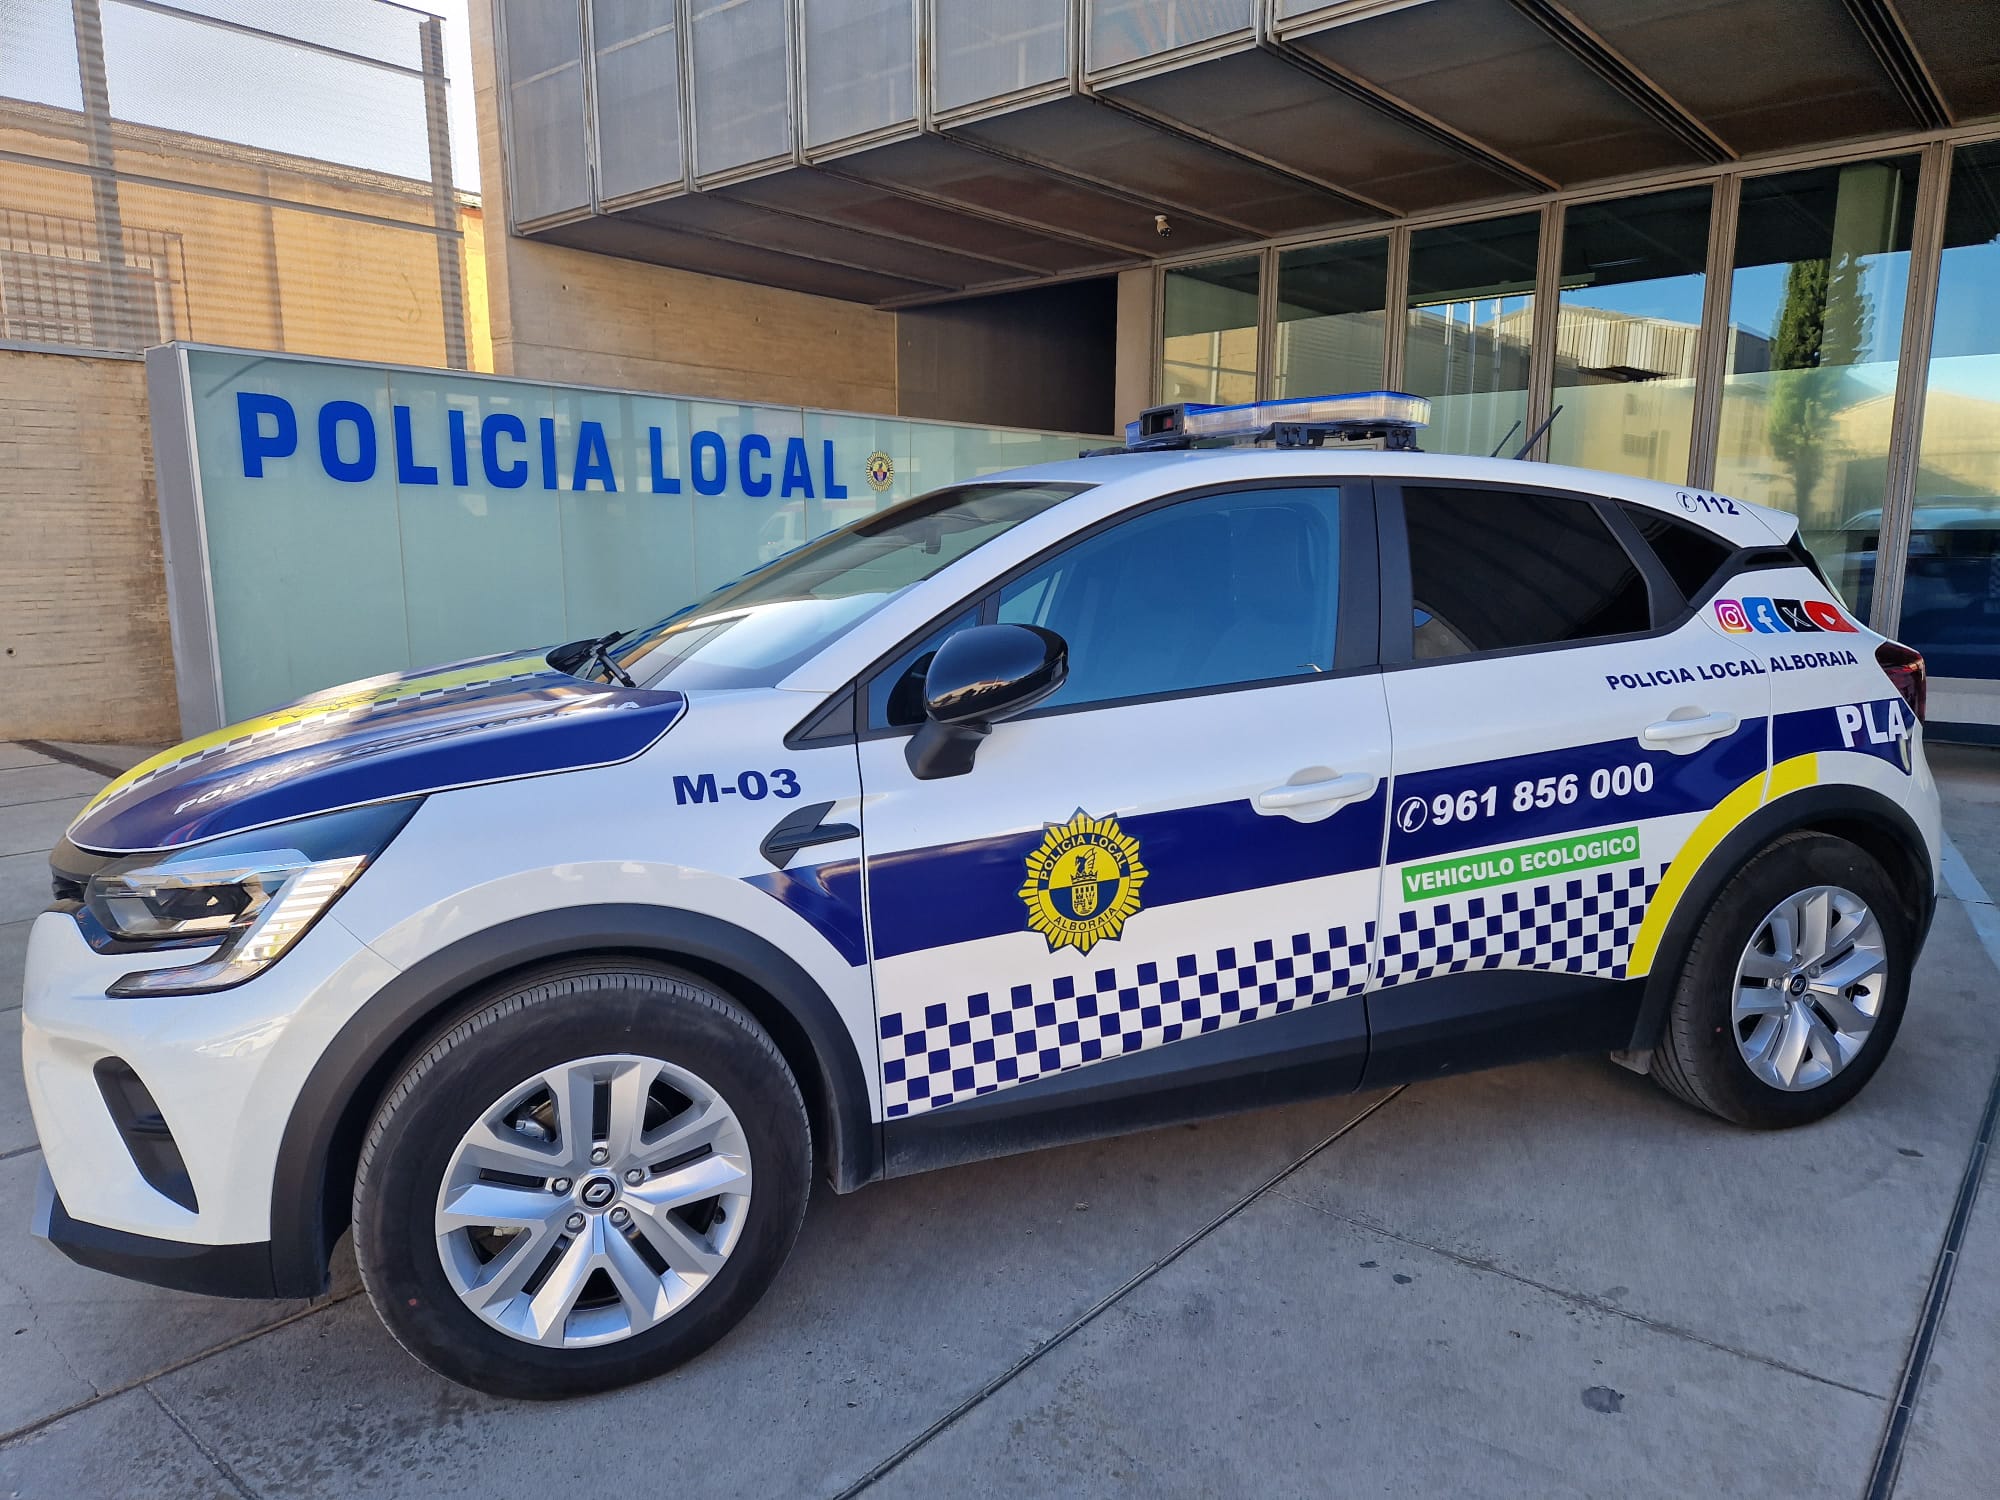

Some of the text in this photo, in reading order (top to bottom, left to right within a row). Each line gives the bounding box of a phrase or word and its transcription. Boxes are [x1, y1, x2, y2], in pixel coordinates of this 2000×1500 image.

[237, 392, 848, 500] POLICIA LOCAL
[1697, 495, 1740, 516] 112
[1606, 650, 1858, 690] POLICIA LOCAL ALBORAIA
[1835, 700, 1908, 748] PLA
[672, 768, 802, 805] M-03
[1432, 762, 1654, 826] 961 856 000
[1040, 834, 1129, 880] POLICIA LOCAL
[1406, 835, 1637, 893] VEHICULO ECOLOGICO
[1054, 907, 1117, 931] ALBORAIA
